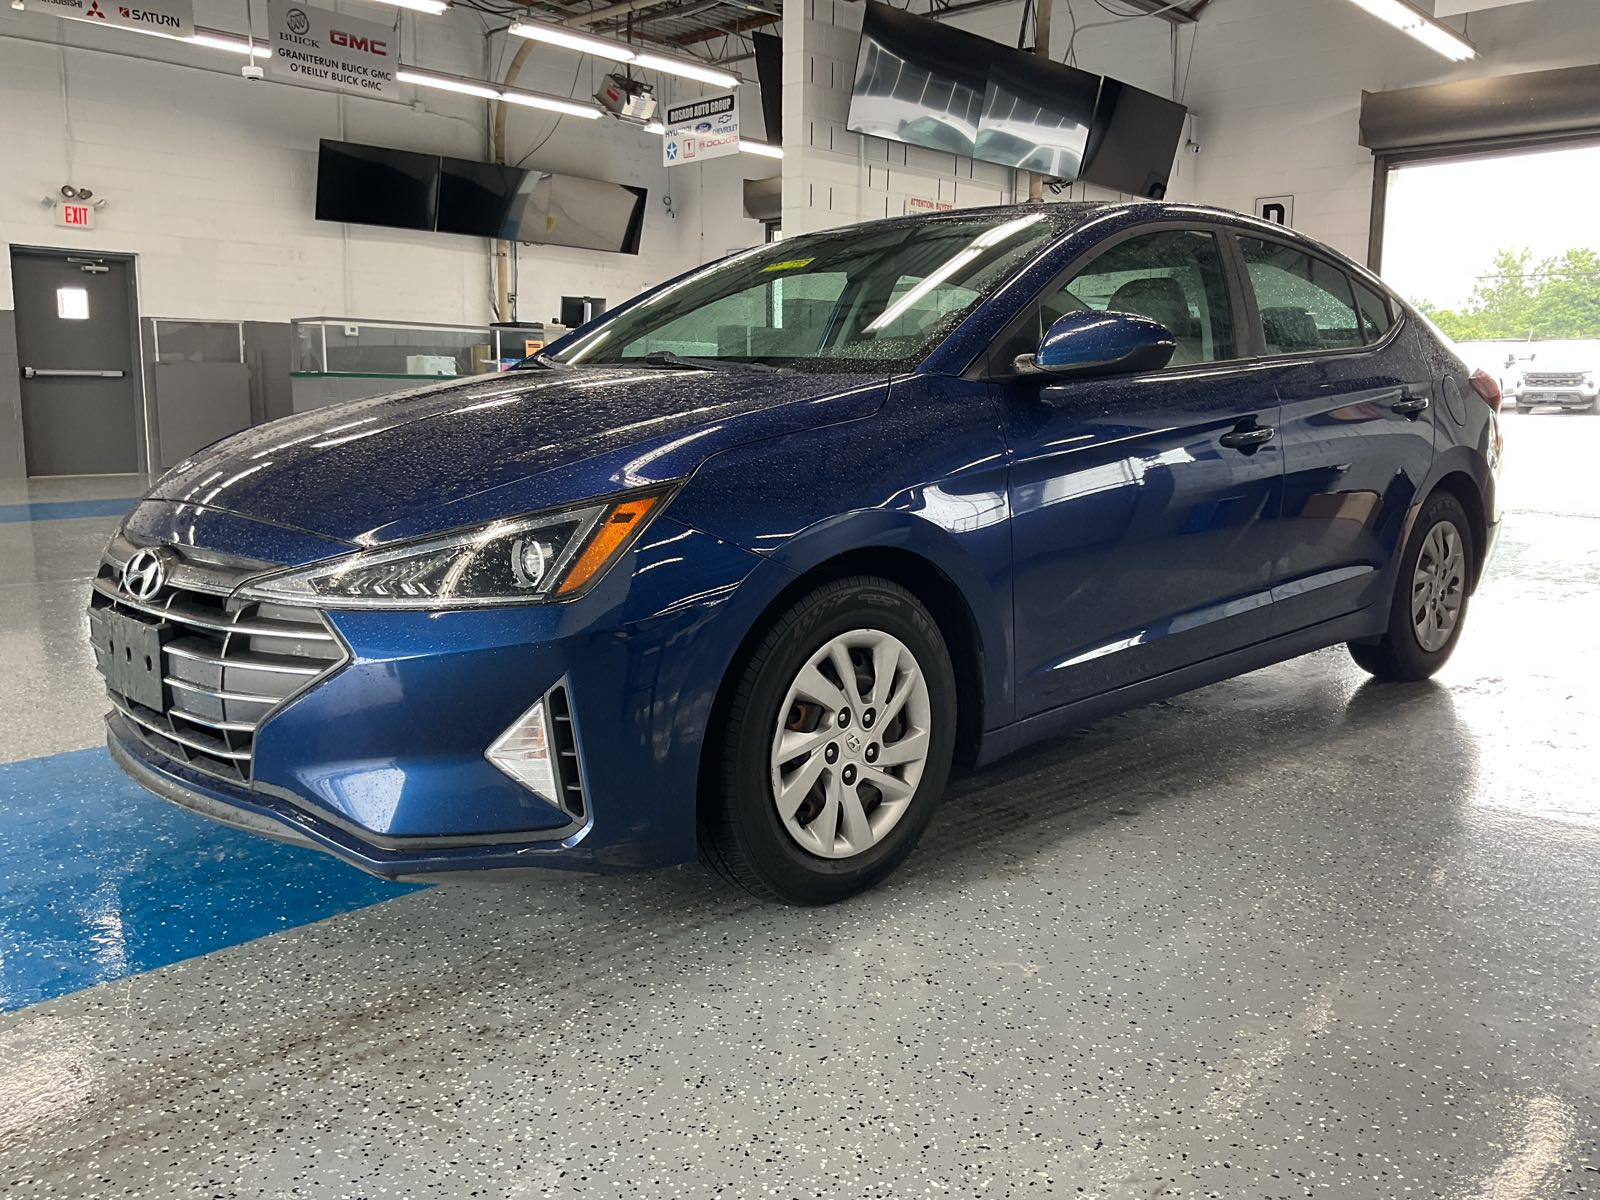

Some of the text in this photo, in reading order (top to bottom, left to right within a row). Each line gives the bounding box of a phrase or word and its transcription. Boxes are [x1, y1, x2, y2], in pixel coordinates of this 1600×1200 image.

[132, 9, 180, 27] SATURN
[280, 32, 320, 48] BUICK
[329, 29, 387, 56] GMC
[278, 47, 392, 82] GRANITERUN BUICK GMC
[290, 62, 382, 91] O'REILLY BUICK GMC
[694, 102, 710, 117] AUTO
[710, 98, 731, 113] GROUP
[64, 205, 88, 225] EXIT
